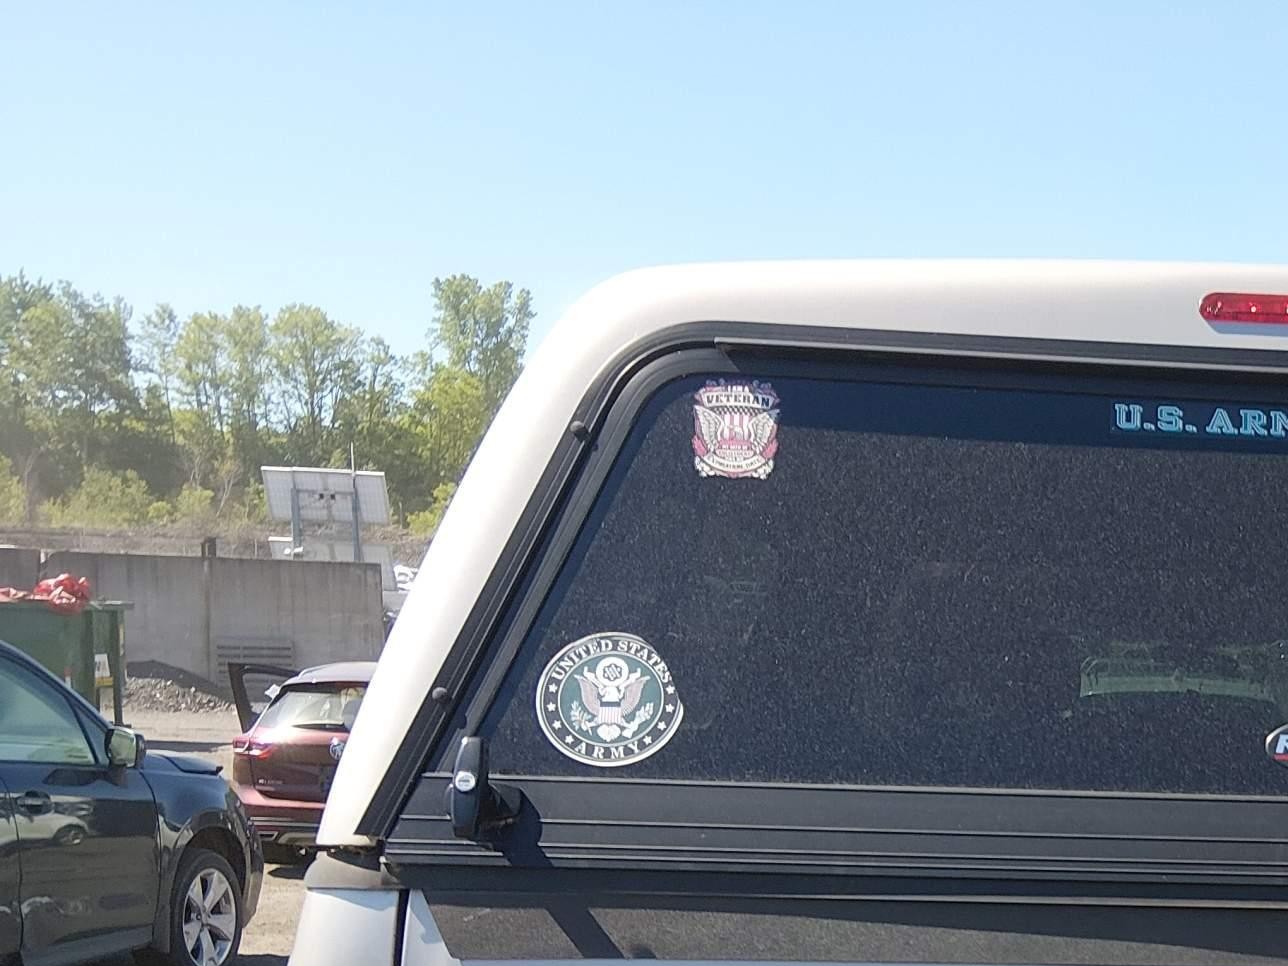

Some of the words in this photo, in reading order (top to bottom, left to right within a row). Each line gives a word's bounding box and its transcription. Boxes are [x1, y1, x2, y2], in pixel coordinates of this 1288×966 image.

[706, 394, 770, 407] VETERAN
[1114, 403, 1198, 432] U.S.
[551, 638, 613, 681] UNITED
[617, 639, 673, 683] STATES
[574, 741, 640, 759] ARMY
